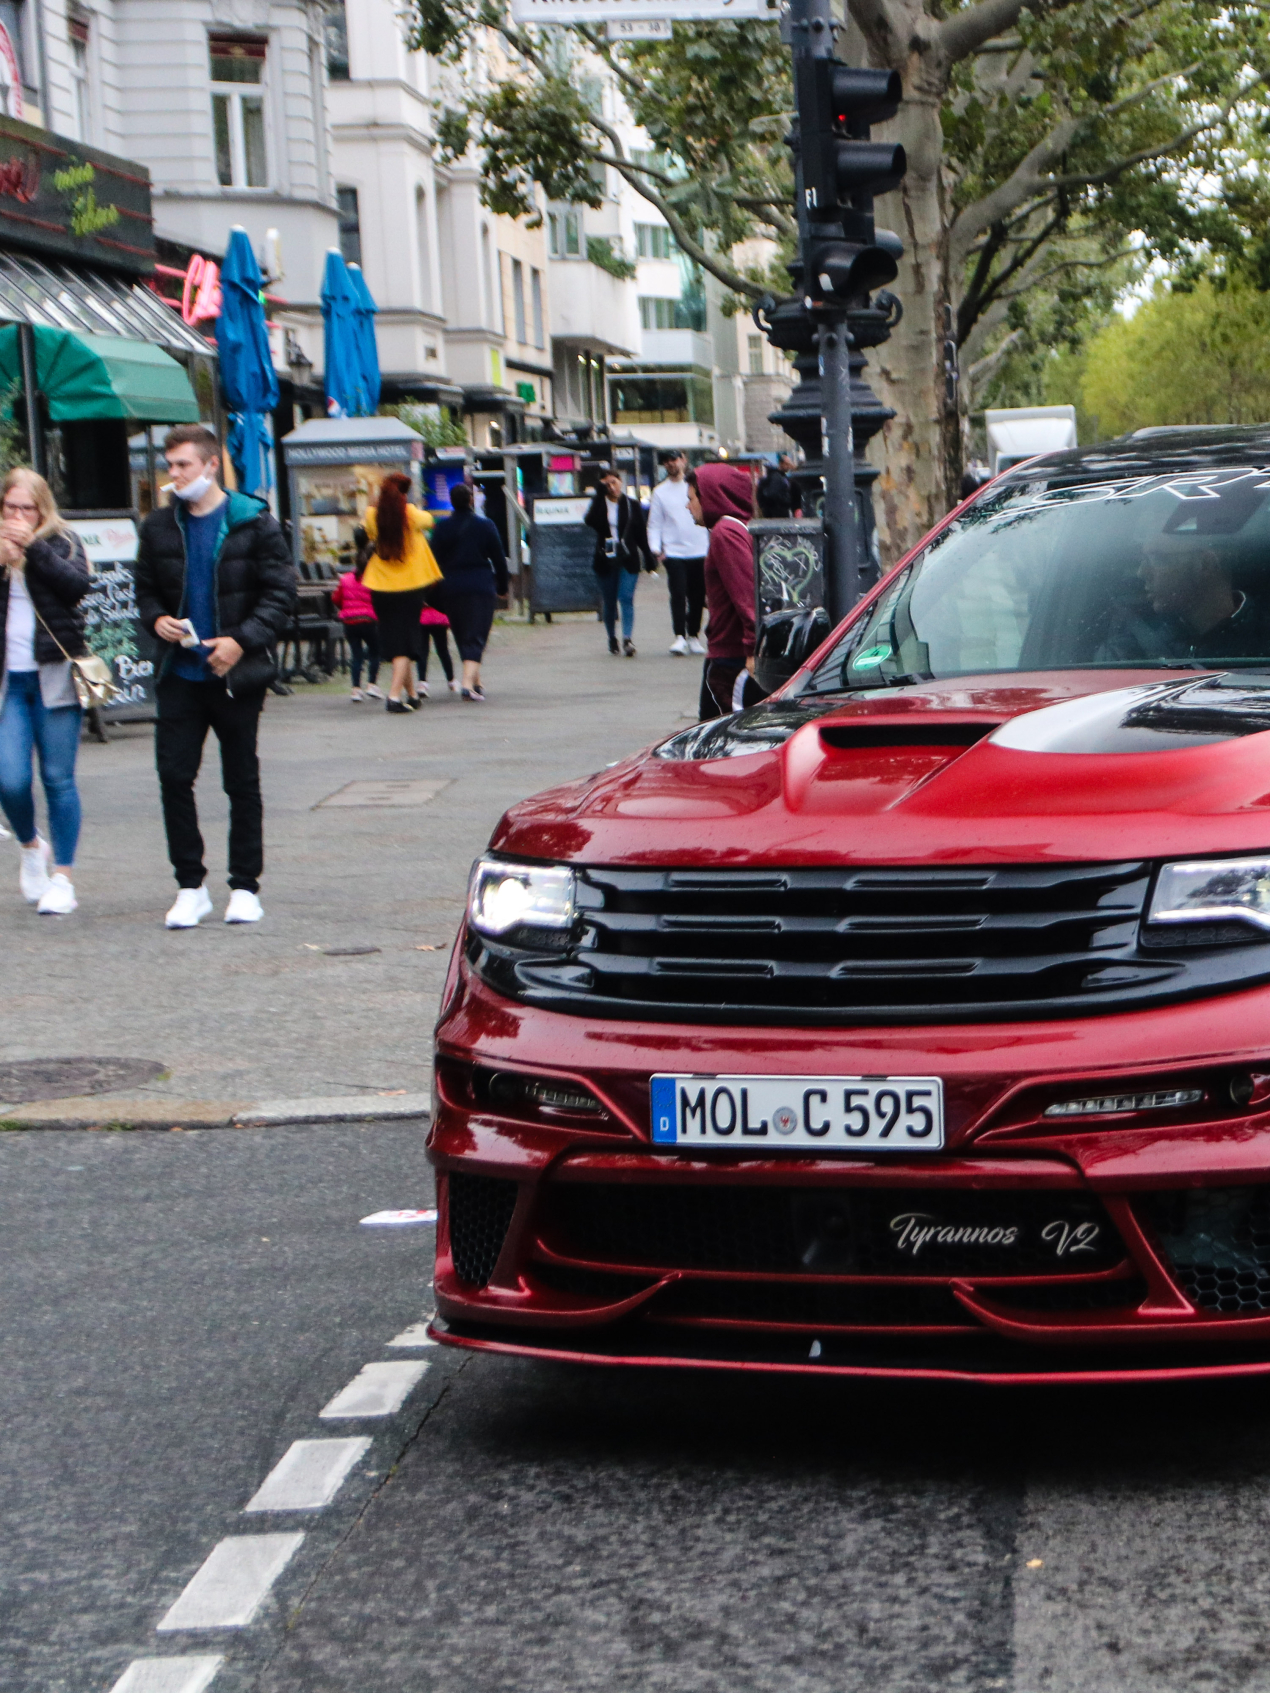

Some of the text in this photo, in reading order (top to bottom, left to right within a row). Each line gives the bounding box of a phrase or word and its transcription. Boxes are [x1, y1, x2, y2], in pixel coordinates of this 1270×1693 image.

[659, 1086, 934, 1138] D MOL C 595
[889, 1212, 1100, 1256] Tyrannos V2
